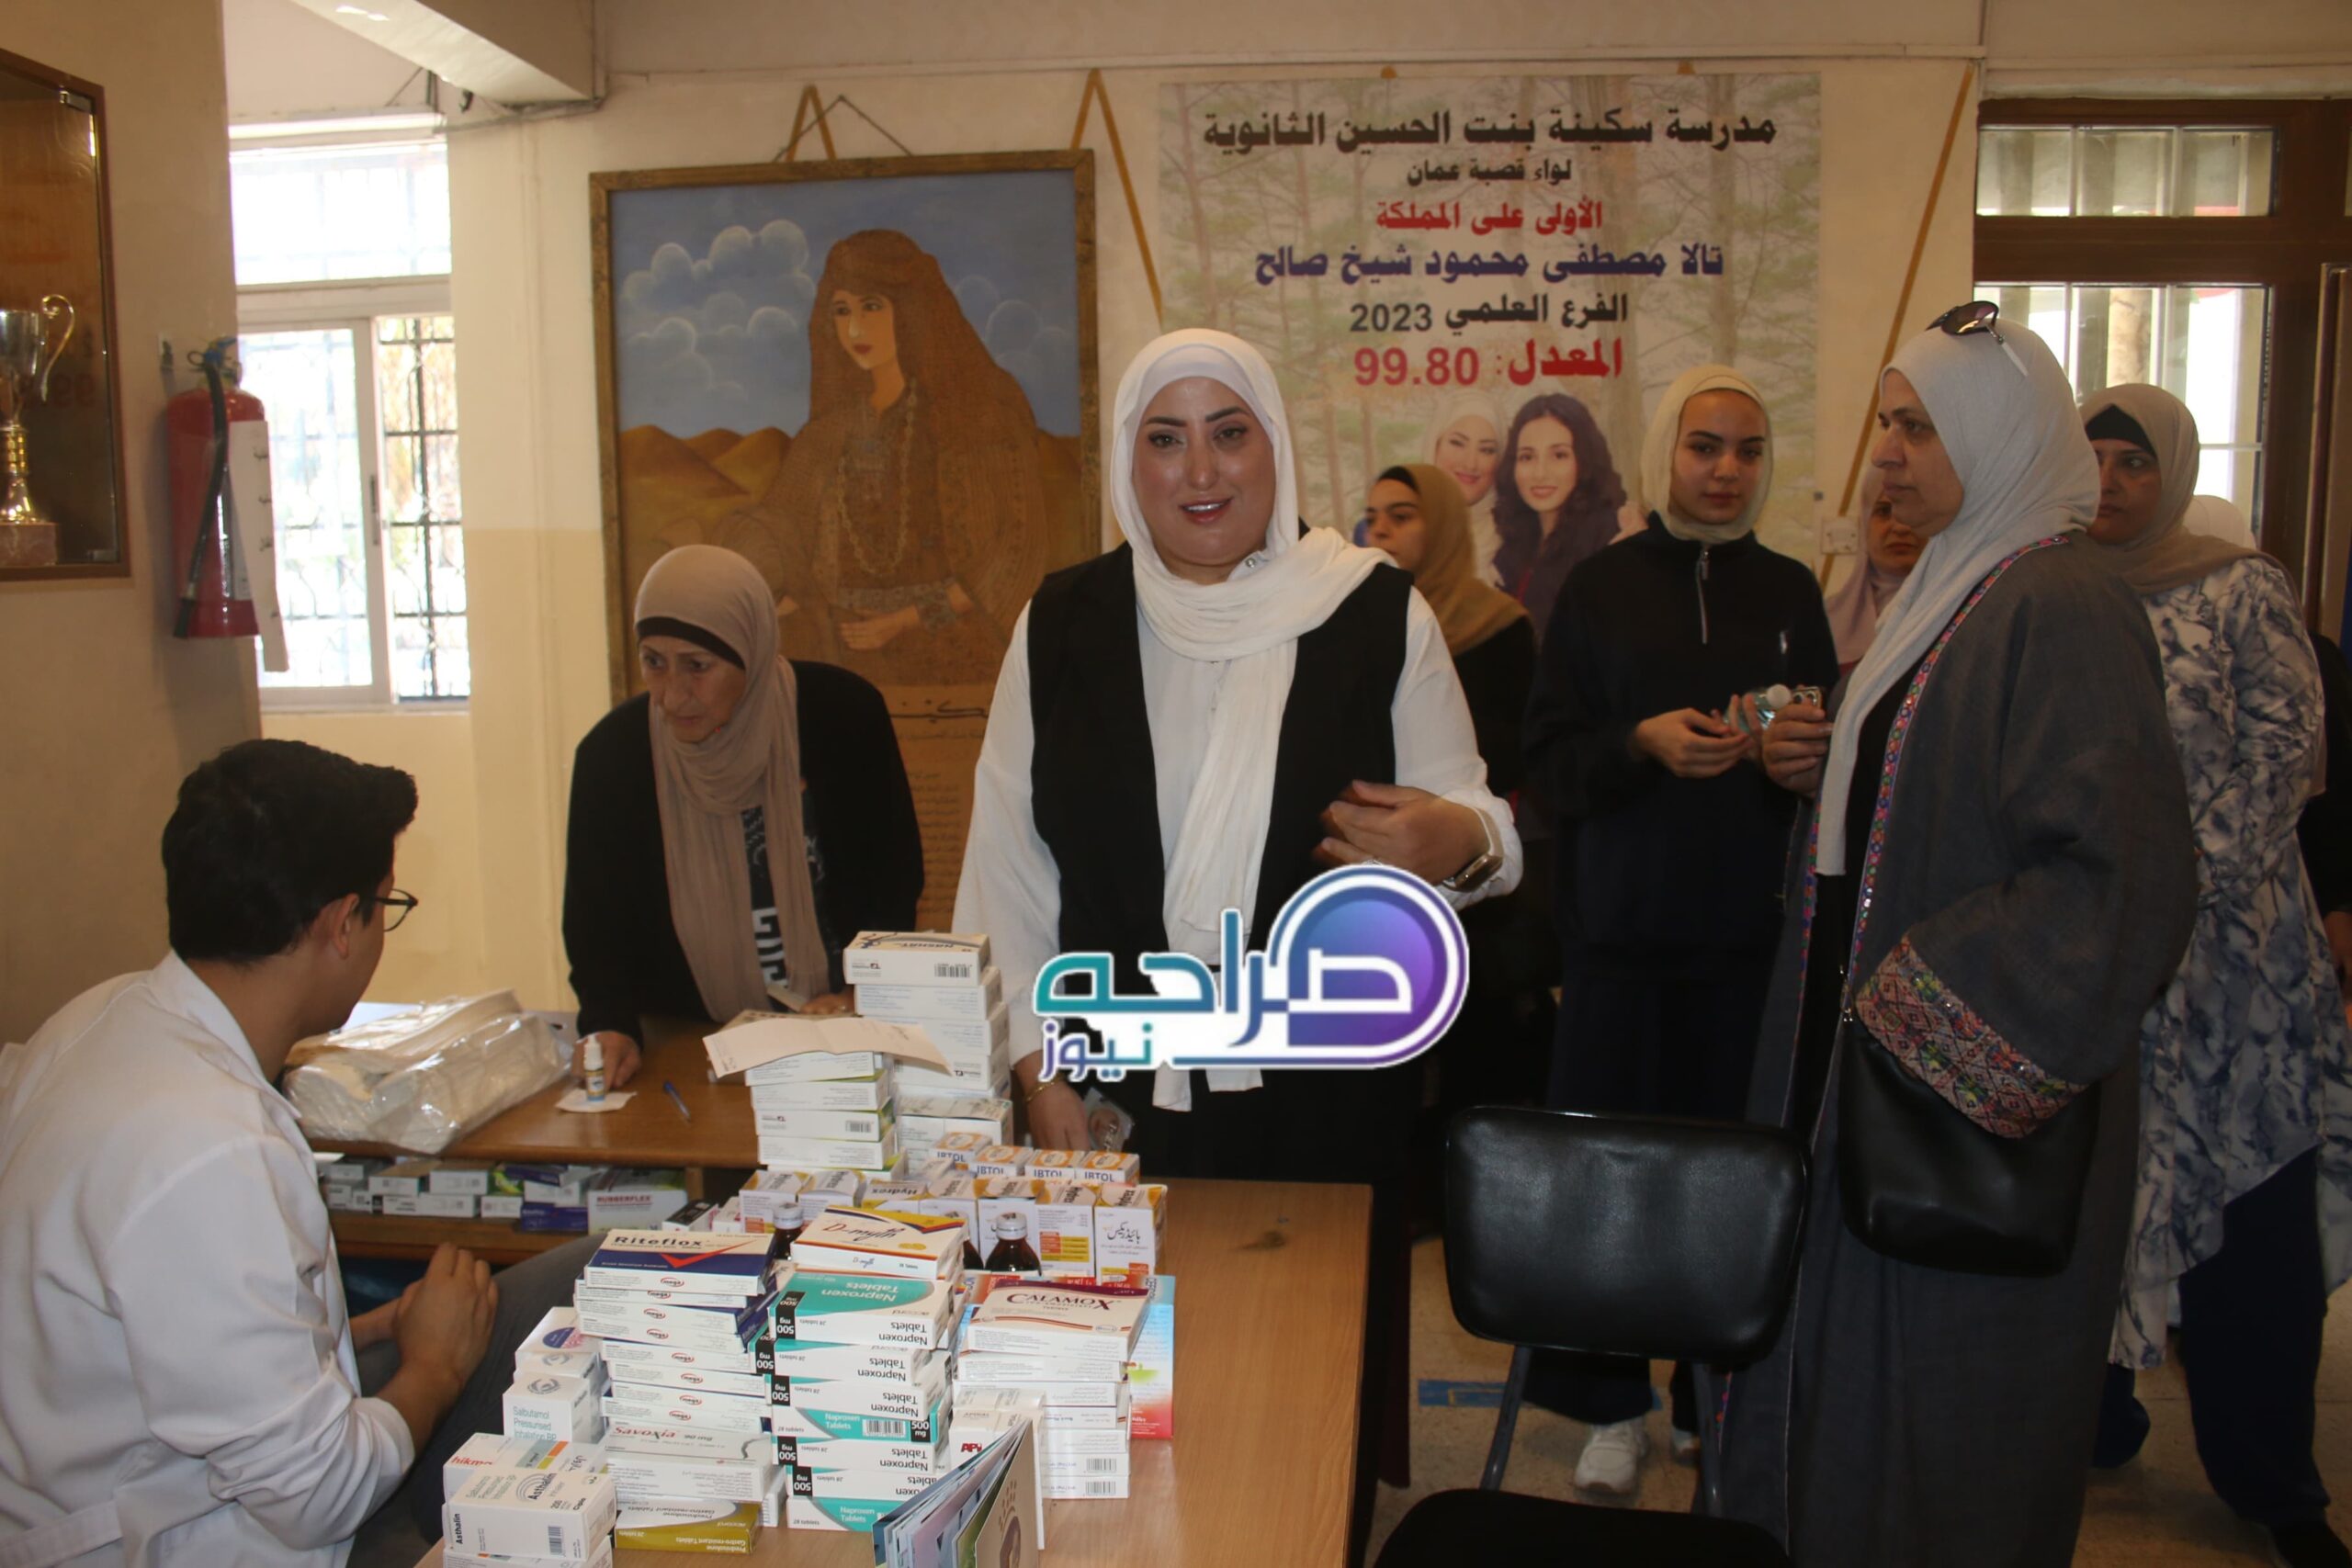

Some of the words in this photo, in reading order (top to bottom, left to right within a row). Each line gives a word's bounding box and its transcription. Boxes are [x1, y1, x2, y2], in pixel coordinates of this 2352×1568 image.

[1204, 112, 1326, 156] الثانوية
[1336, 110, 1451, 155] الحسين
[1464, 112, 1535, 152] بنت
[1549, 107, 1653, 150] سكينة
[1666, 107, 1778, 152] مدرسة
[1407, 160, 1461, 187] عمان
[1469, 157, 1525, 181] قصبة
[1533, 158, 1572, 186] لواء
[1376, 201, 1460, 231] المملكة
[1471, 202, 1524, 236] على
[1535, 195, 1603, 236] الأولى
[1256, 246, 1328, 286] صالح
[1341, 243, 1411, 285] شيخ
[1425, 251, 1530, 284] محمود
[1543, 243, 1667, 283] مصطفى
[1681, 243, 1723, 275] تالا
[1350, 303, 1432, 333] 2023
[1445, 293, 1548, 336] العلمي
[1561, 291, 1629, 330] الفرع
[1355, 347, 1478, 386] 99.80
[613, 1235, 704, 1247] Riteflox
[821, 1289, 898, 1302] Naproxen
[846, 1281, 899, 1293] Tablets
[1007, 1292, 1115, 1311] CALAMOX
[776, 1325, 795, 1335] 500
[890, 1321, 927, 1333] Tablets
[879, 1333, 928, 1346] Naproxen
[756, 1359, 775, 1370] 500
[869, 1358, 906, 1370] Tablets
[857, 1369, 906, 1382] Naproxen
[772, 1392, 789, 1402] 500
[883, 1392, 918, 1404] Tablets
[513, 1405, 550, 1418] Salbutamol
[871, 1403, 919, 1416] Naproxen
[613, 1425, 676, 1439] Savoxia
[910, 1421, 930, 1430] 500
[778, 1451, 796, 1461] 500
[892, 1448, 927, 1460] Tablets
[880, 1459, 928, 1472] Naproxen
[794, 1482, 811, 1492] 500
[908, 1475, 937, 1485] ablets
[454, 1513, 464, 1545] Asthalin
